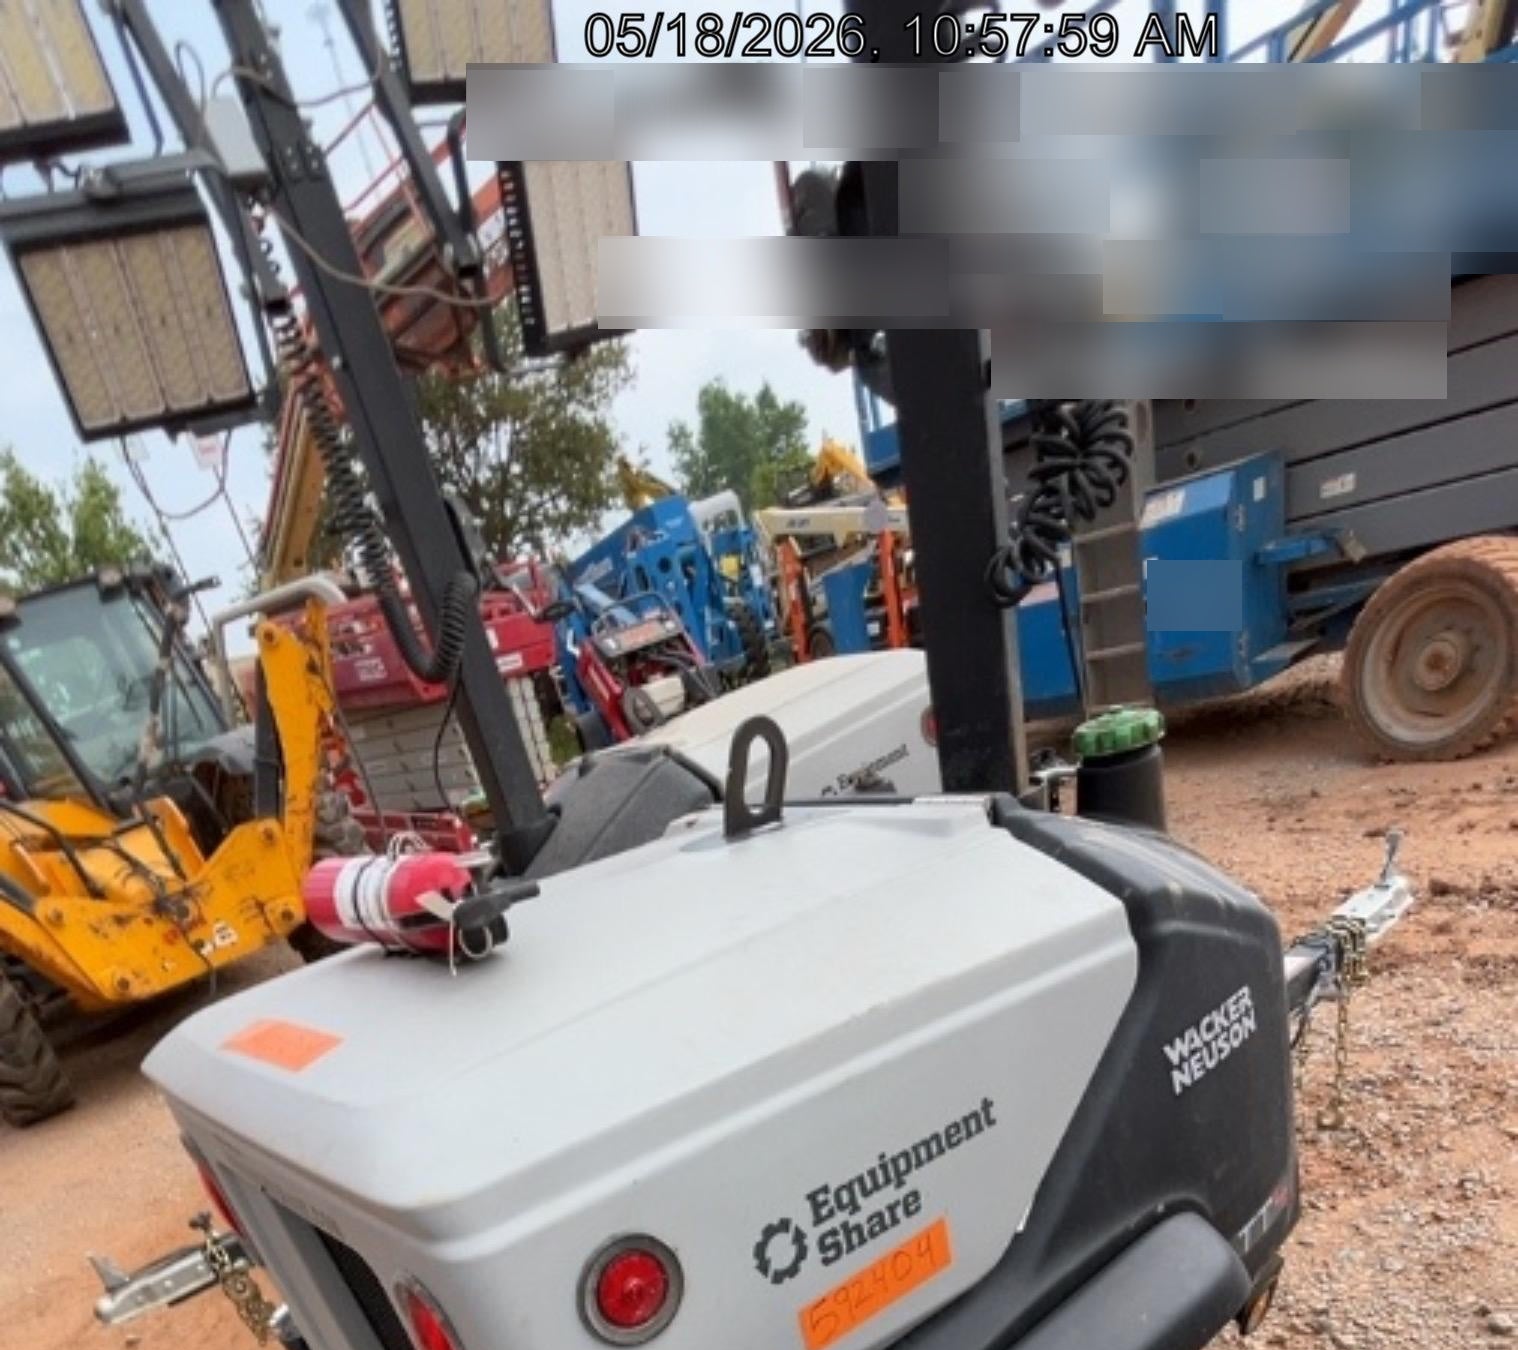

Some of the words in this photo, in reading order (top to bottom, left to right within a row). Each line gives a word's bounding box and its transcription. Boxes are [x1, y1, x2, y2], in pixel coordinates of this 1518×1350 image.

[1162, 984, 1253, 1067] WACKER
[1171, 1006, 1257, 1097] NEUSON
[805, 1097, 996, 1227] Equipment
[816, 1189, 922, 1267] Share
[810, 1231, 937, 1345] 592404
